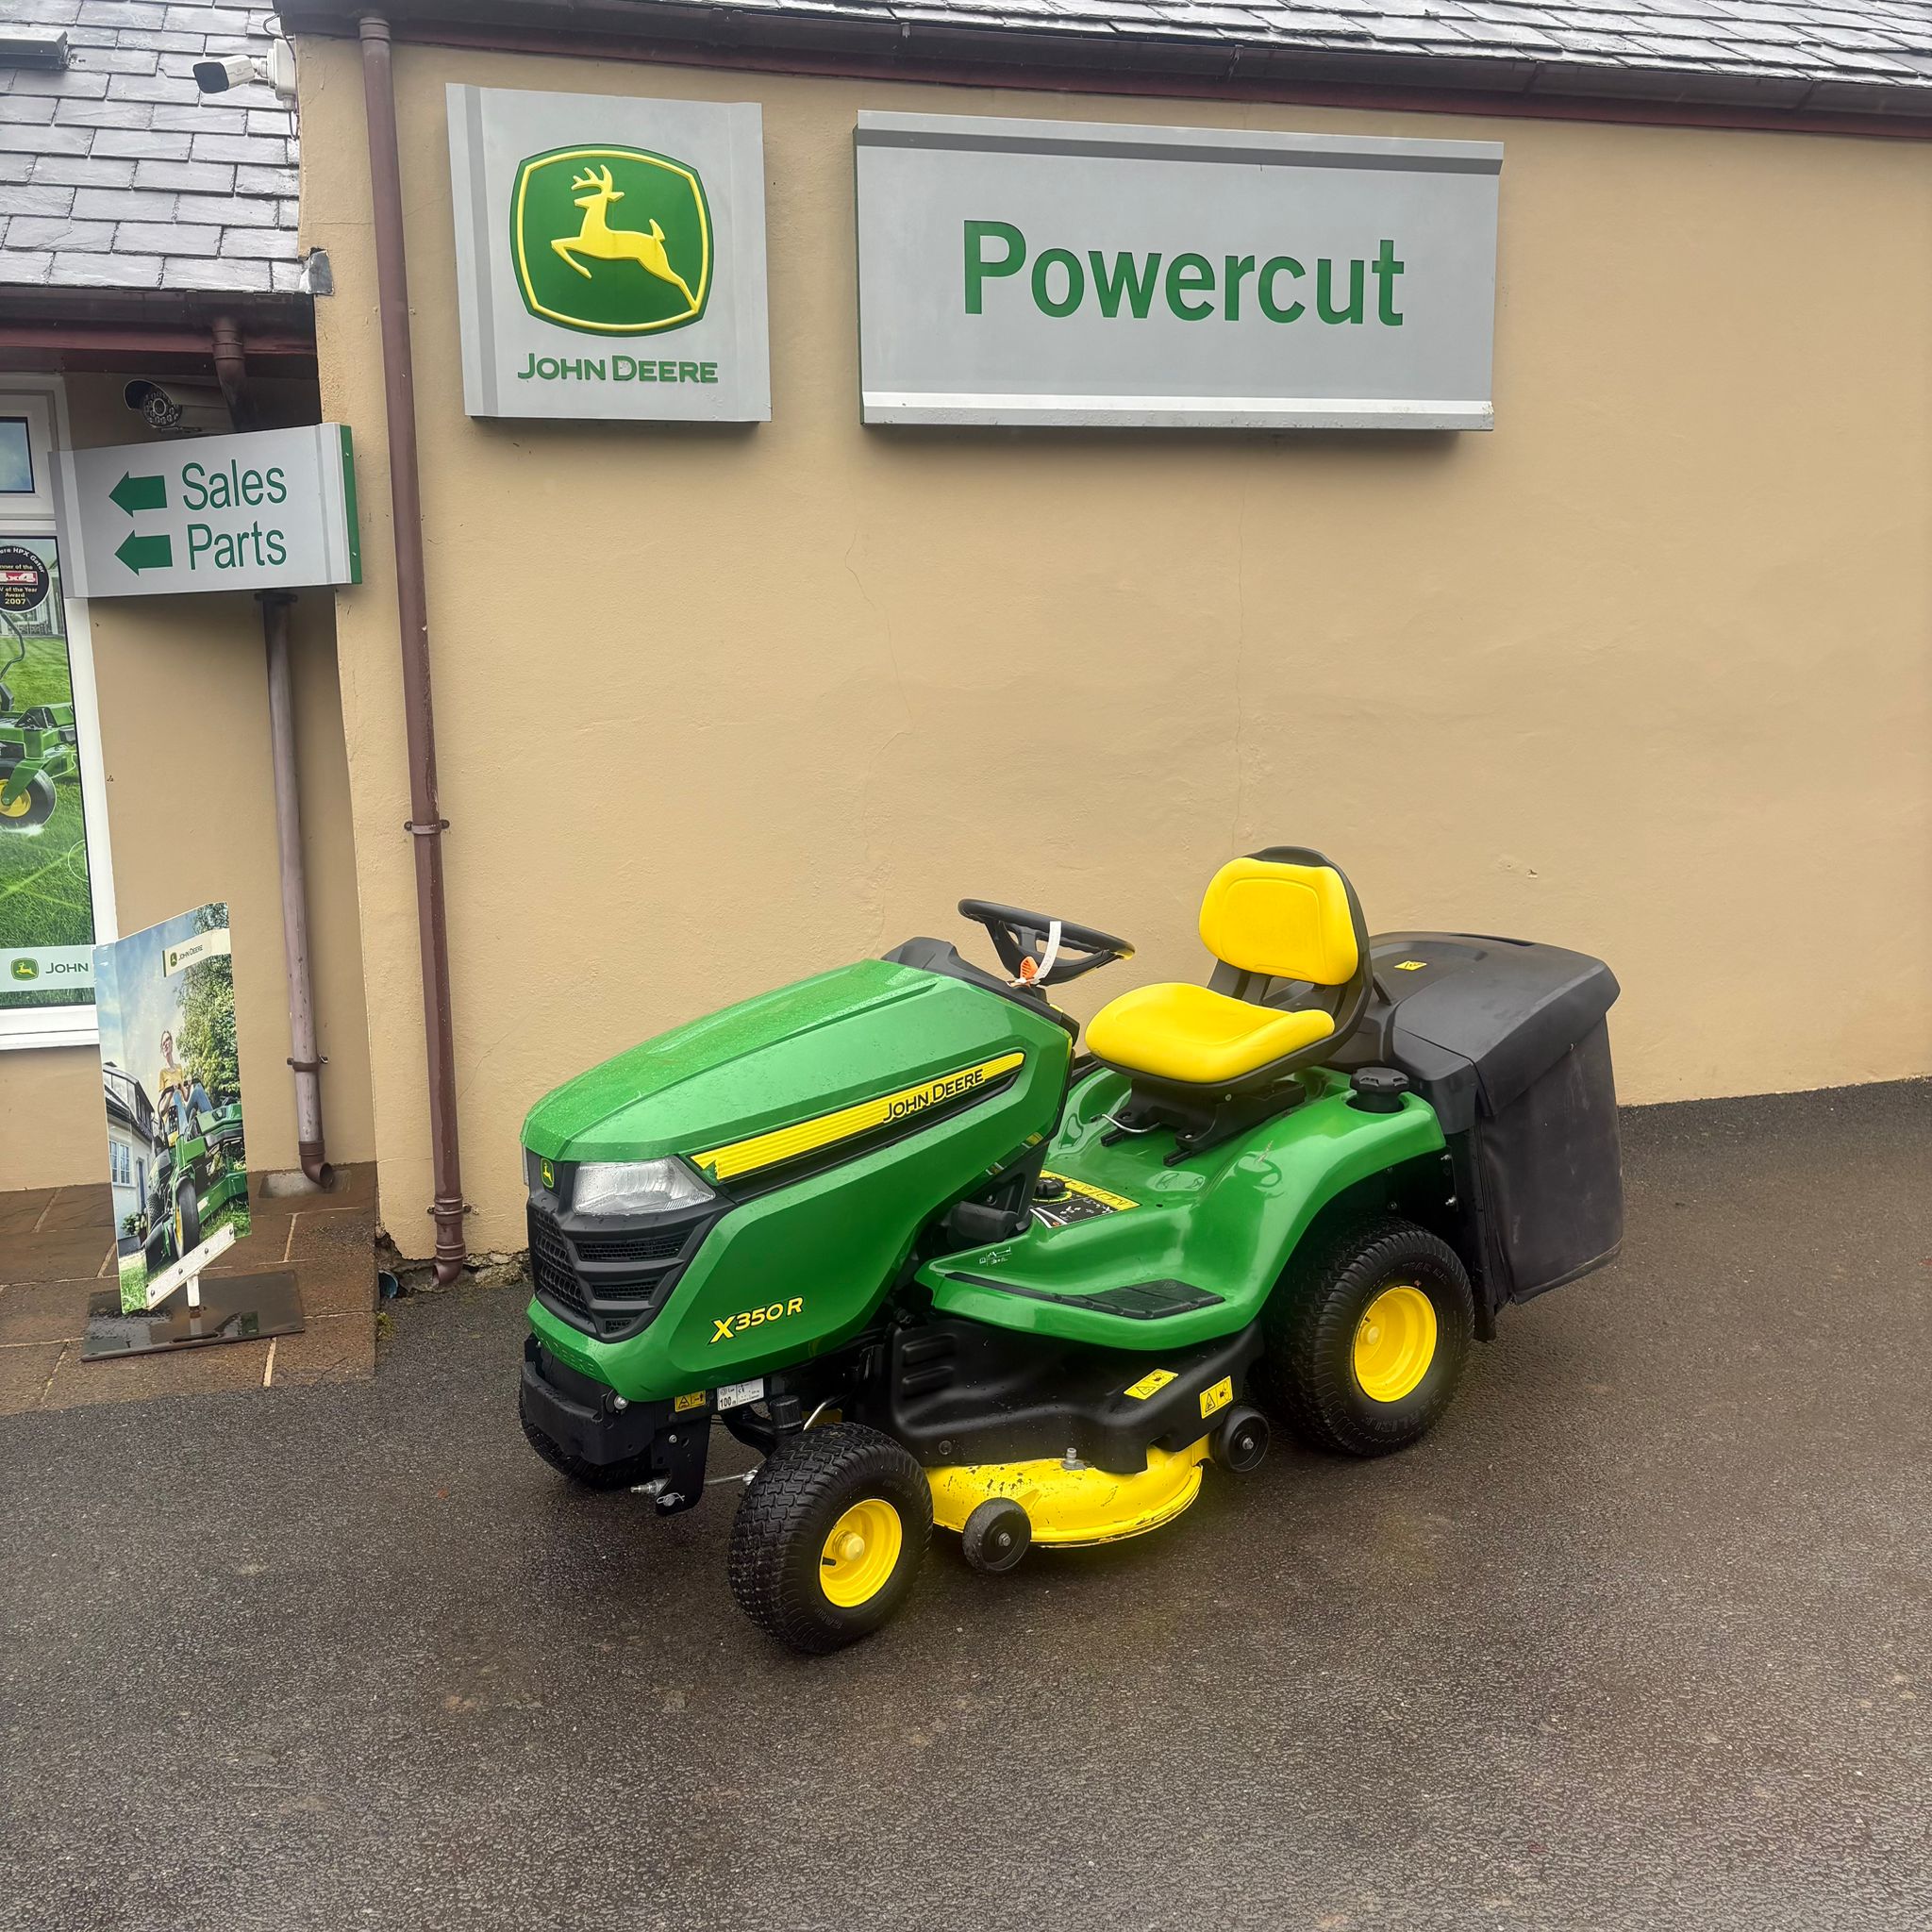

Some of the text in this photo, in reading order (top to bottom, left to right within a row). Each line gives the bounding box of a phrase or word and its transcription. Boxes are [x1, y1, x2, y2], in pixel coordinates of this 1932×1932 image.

[963, 220, 1405, 326] Powercut
[517, 353, 718, 383] JOHN DEERE
[181, 458, 287, 510] Sales
[12, 547, 29, 557] HPX
[29, 555, 45, 574] Gator
[187, 521, 287, 570] Parts
[45, 962, 89, 974] JOHN
[883, 1069, 985, 1122] JOHN DEERE
[720, 1396, 732, 1408] 100
